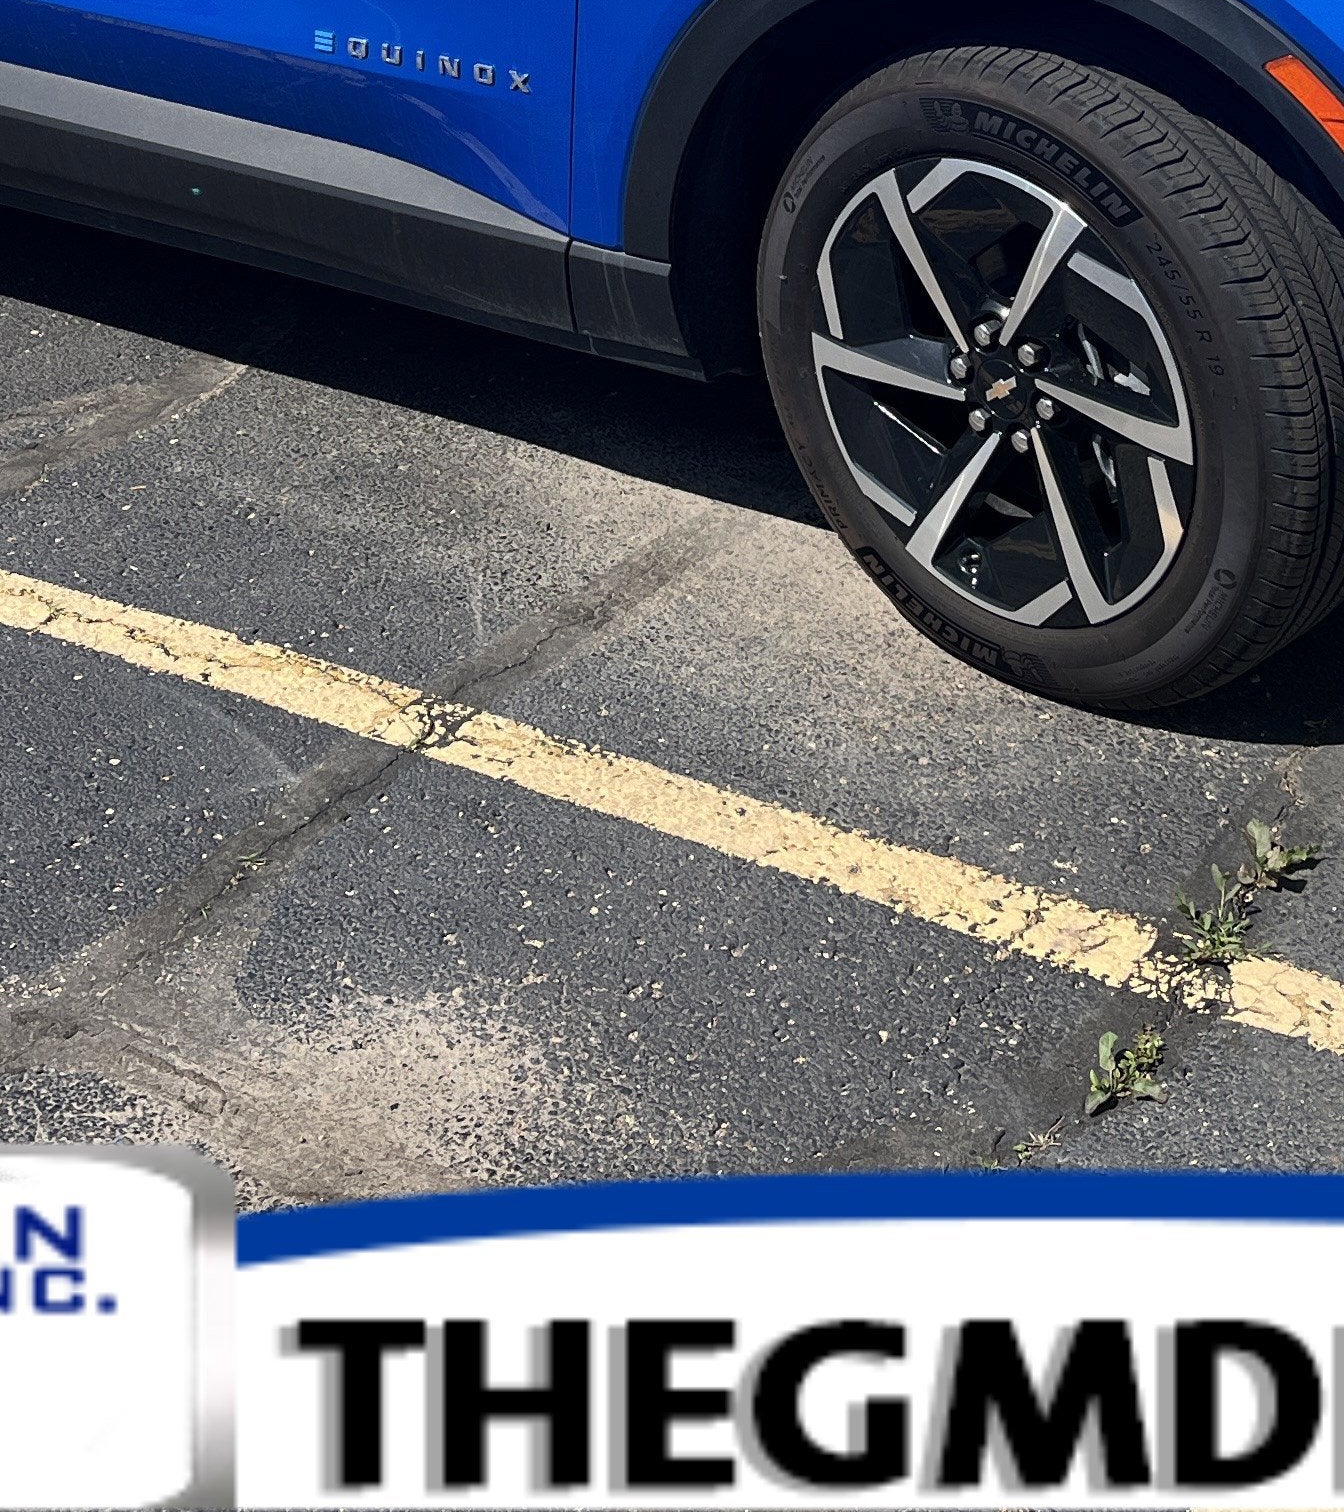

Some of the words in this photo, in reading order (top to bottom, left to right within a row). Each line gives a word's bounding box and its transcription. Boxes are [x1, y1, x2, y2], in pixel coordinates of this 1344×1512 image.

[314, 29, 532, 94] EQUINOX
[973, 109, 1132, 219] MICHELIN
[1144, 241, 1204, 321] 245/55
[1194, 329, 1213, 344] R
[861, 553, 999, 667] MICHELIN
